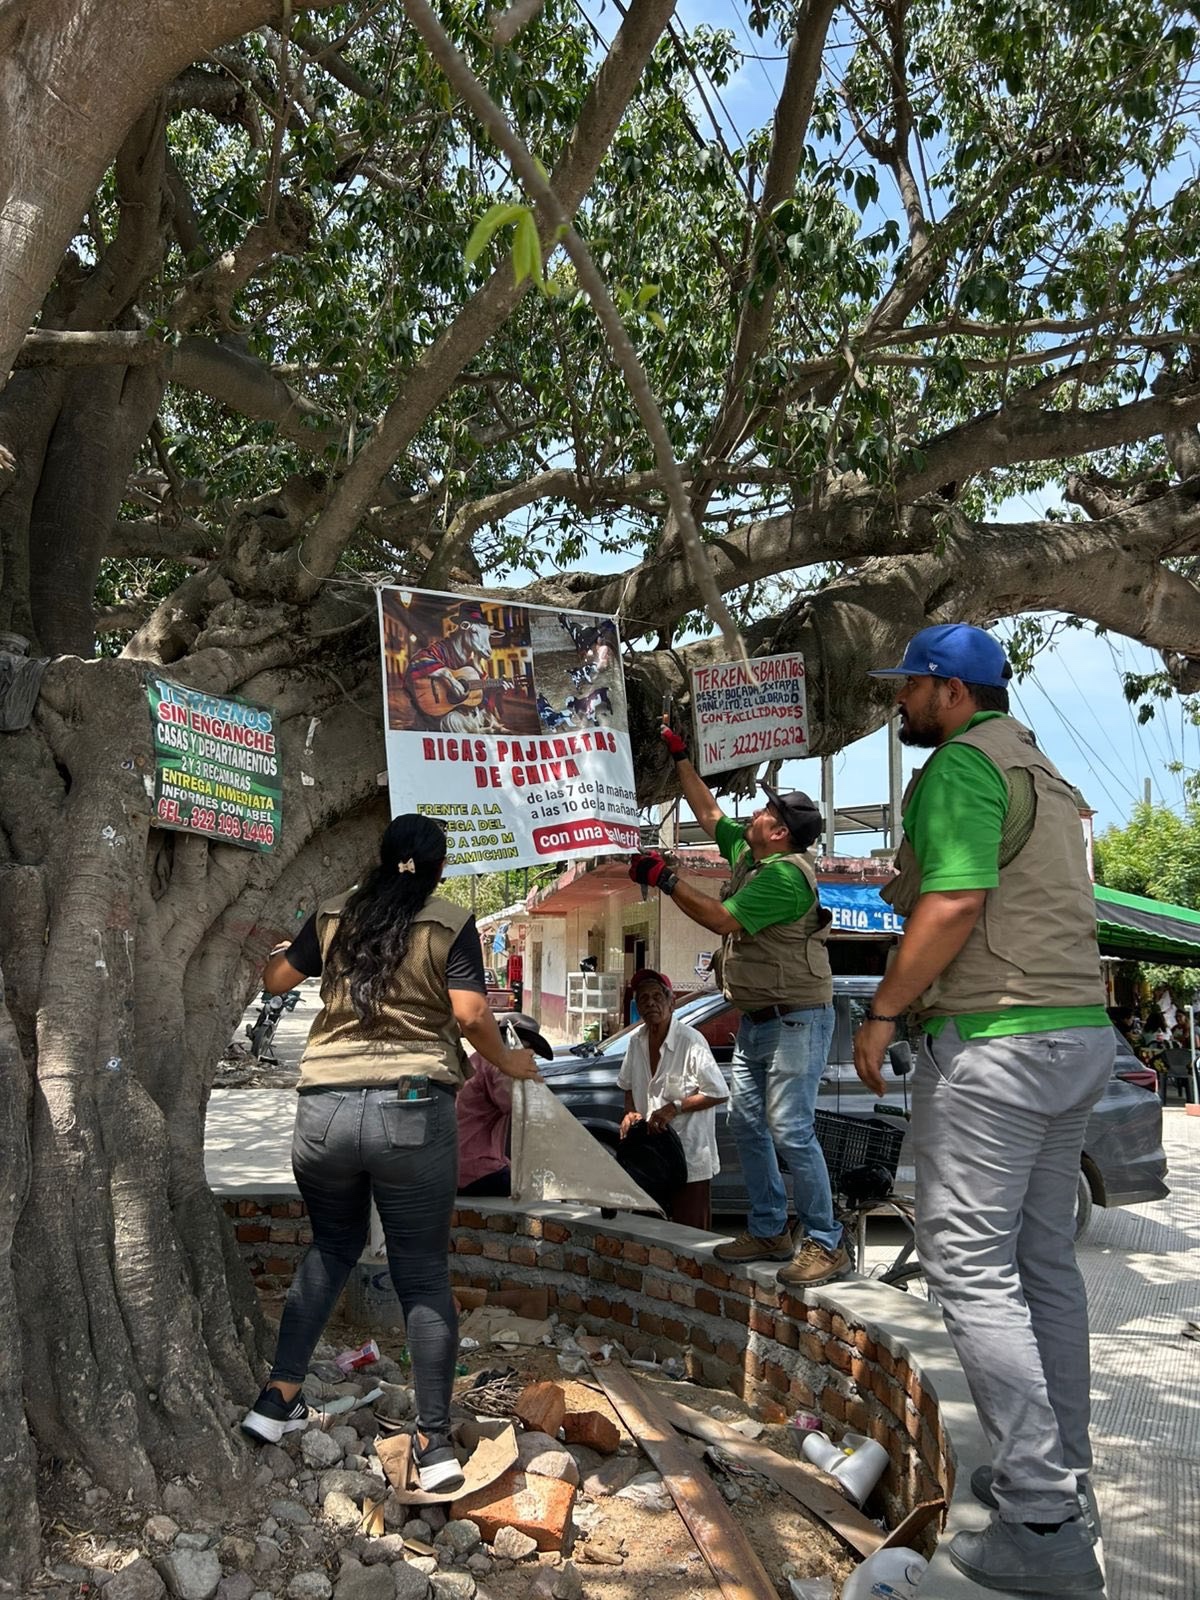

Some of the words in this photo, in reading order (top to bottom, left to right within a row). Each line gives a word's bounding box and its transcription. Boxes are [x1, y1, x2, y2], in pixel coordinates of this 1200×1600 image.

[760, 657, 804, 682] BARATOS
[761, 679, 800, 693] IXTAPA
[155, 679, 272, 733] TERRENOS
[701, 713, 723, 724] CON
[723, 705, 804, 724] FACILIDADES
[743, 698, 753, 708] EL
[158, 701, 188, 726] SIN
[191, 711, 276, 754] ENGANCHE
[157, 723, 188, 751] CASAS
[190, 732, 197, 748] Y
[199, 735, 277, 776] DEPARTAMENTOS
[422, 737, 488, 762] RICAS
[496, 731, 617, 762] PAJARETAS
[181, 756, 187, 772] 2
[188, 757, 195, 772] Y
[195, 760, 201, 775] 3
[202, 762, 251, 791] RECAMARAS
[474, 766, 502, 788] DE
[511, 758, 580, 787] CHIVA
[162, 767, 212, 795] ENTREGA
[215, 783, 275, 810] INMEDIATA
[527, 792, 543, 804] de
[545, 790, 564, 800] las
[566, 785, 574, 797] 7
[578, 782, 594, 794] de
[595, 780, 604, 793] la
[162, 783, 219, 810] INFORMES
[221, 801, 243, 817] CON
[246, 810, 274, 823] ABEL
[417, 804, 468, 815] FRENTE
[471, 803, 481, 815] A
[483, 803, 503, 815] LA
[531, 810, 539, 819] a
[541, 806, 560, 817] las
[562, 800, 578, 813] 10
[581, 798, 596, 809] de
[597, 797, 605, 811] la
[191, 806, 216, 831] 322
[218, 813, 241, 838] 193
[242, 820, 274, 846] 1446
[444, 819, 476, 832] EGA
[478, 819, 506, 831] DEL
[540, 831, 570, 847] con
[573, 826, 603, 842] una
[446, 836, 455, 848] O
[458, 836, 469, 848] A
[471, 834, 499, 847] 100
[501, 832, 515, 844] M
[446, 846, 519, 865] CAMICHIN
[824, 907, 868, 928] ERIA
